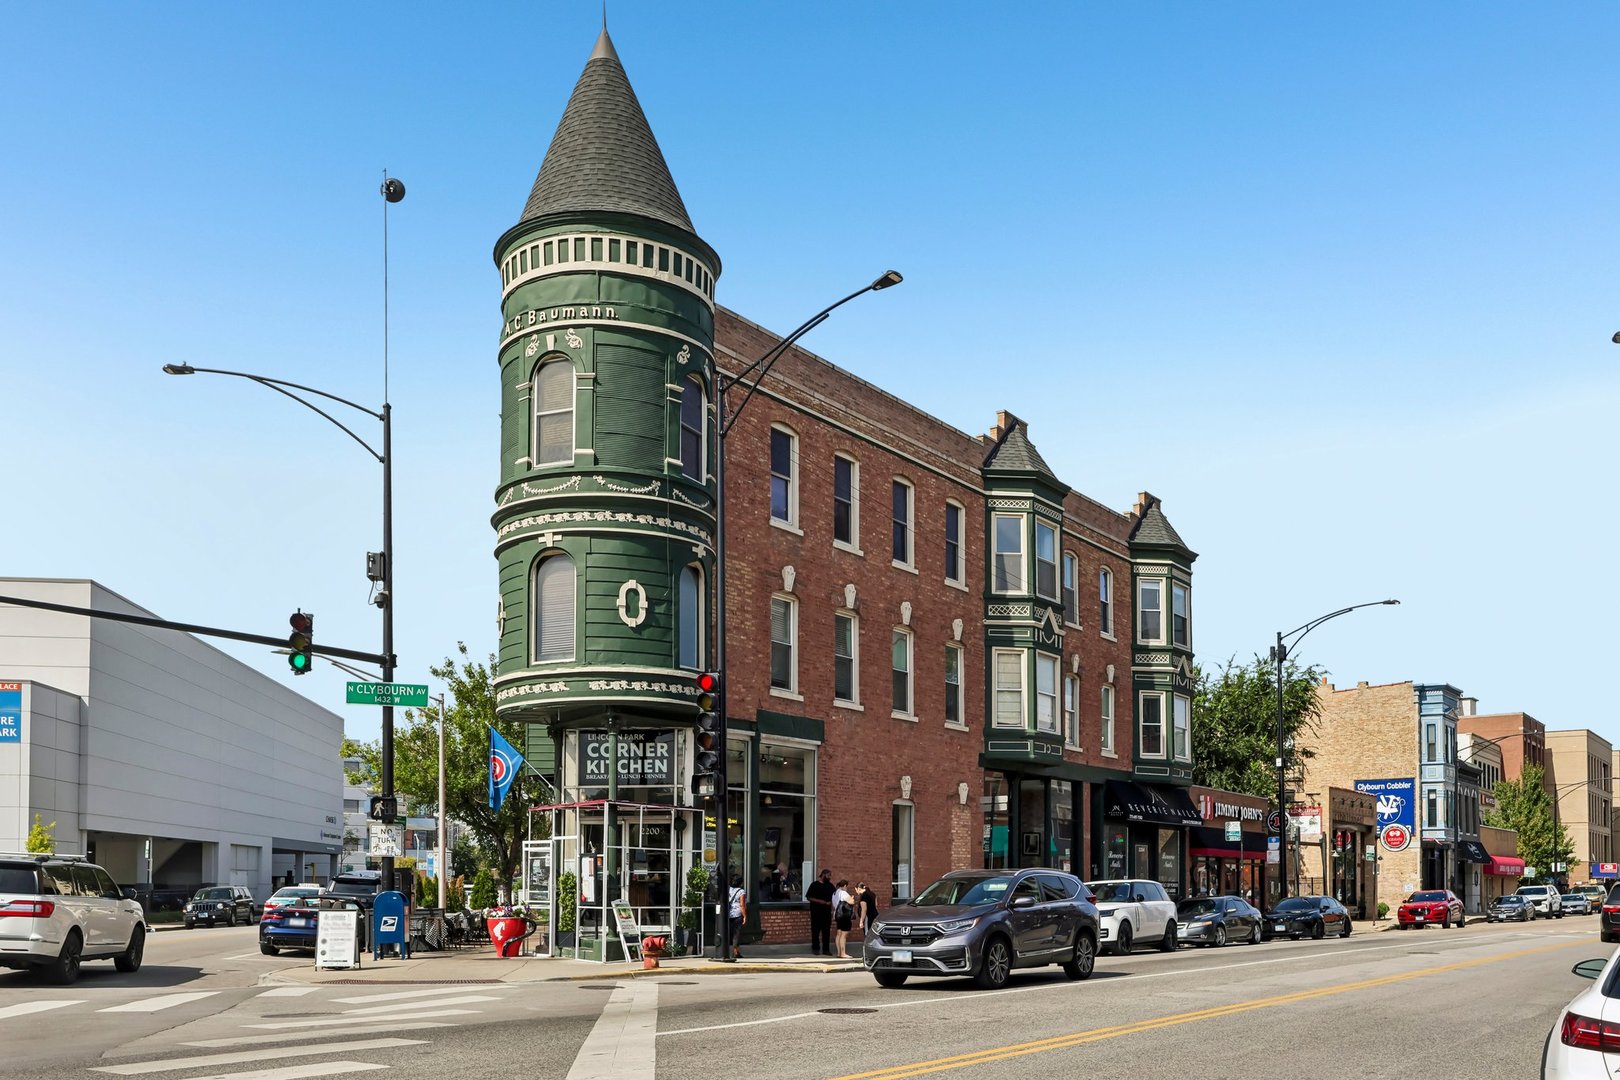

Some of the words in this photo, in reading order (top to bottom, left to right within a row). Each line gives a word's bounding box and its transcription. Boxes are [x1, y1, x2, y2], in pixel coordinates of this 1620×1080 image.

[505, 322, 513, 336] A.
[514, 316, 524, 330] C.
[528, 306, 619, 326] Baumann.
[356, 684, 414, 696] CLYBOURN
[374, 695, 392, 703] 1432
[587, 733, 623, 741] LINCON
[624, 733, 645, 741] PARK
[587, 742, 669, 758] CORNER
[1357, 783, 1386, 792] Clybourn
[1386, 782, 1412, 790] Cobbler
[1128, 803, 1168, 815] REVERIE
[1170, 808, 1197, 818] NAILS
[1215, 802, 1240, 818] JIMMY
[1240, 806, 1263, 821] JOHN'S
[641, 827, 660, 835] 2200
